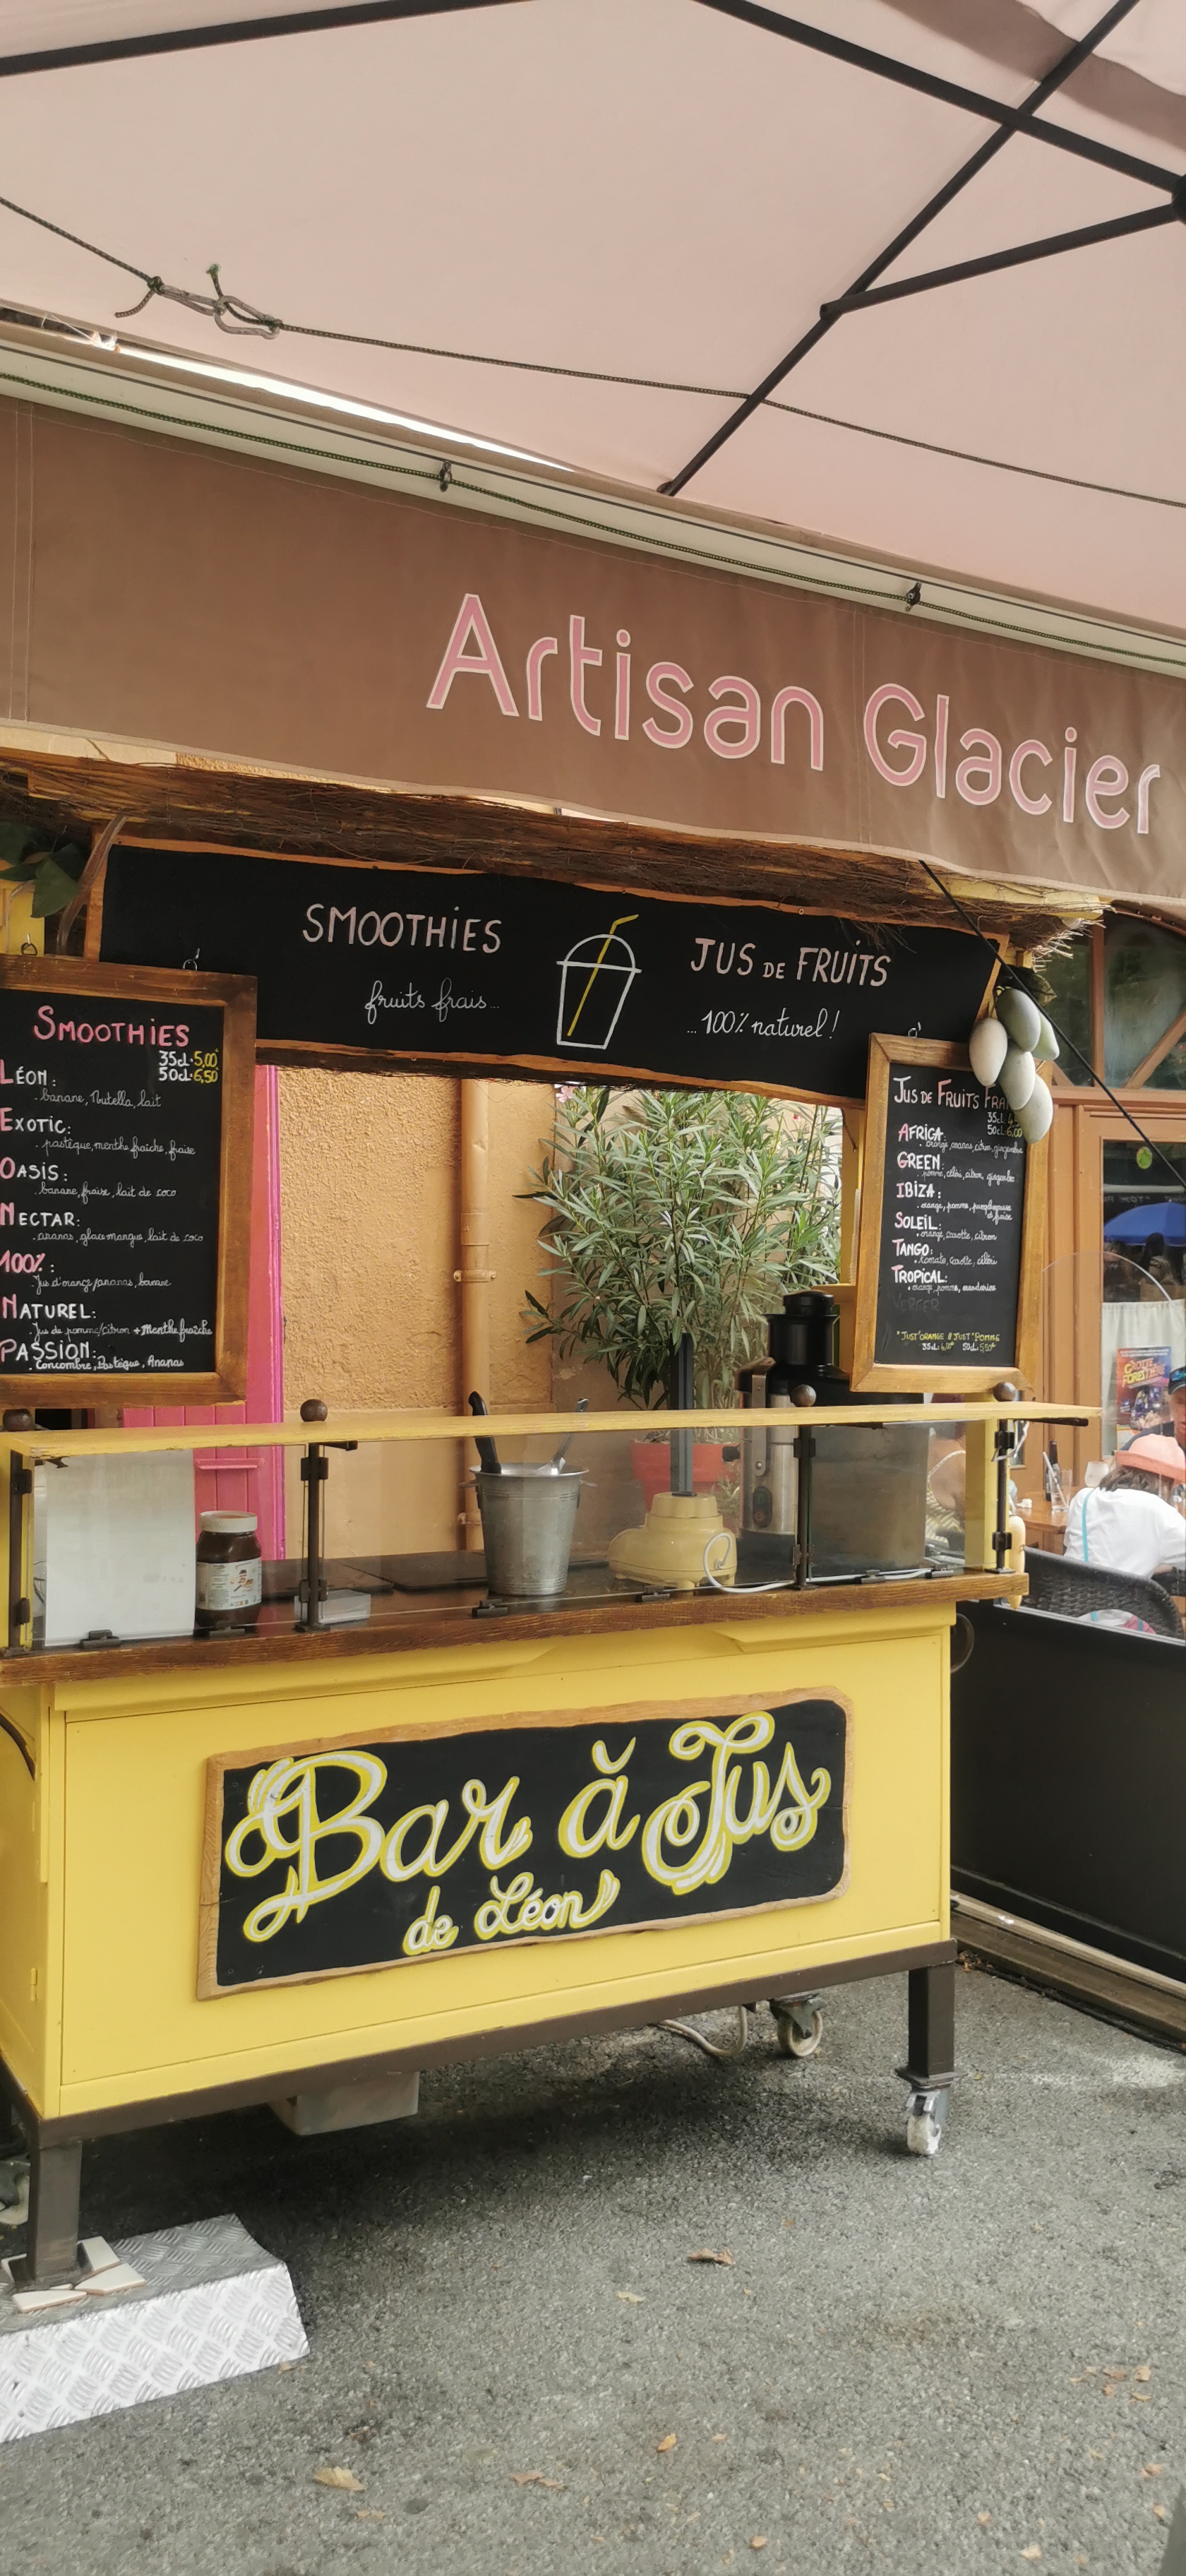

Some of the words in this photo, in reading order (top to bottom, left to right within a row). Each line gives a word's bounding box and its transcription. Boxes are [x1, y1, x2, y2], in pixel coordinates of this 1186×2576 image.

[426, 593, 824, 771] Artisan
[863, 683, 1161, 835] Glacier
[690, 938, 756, 976] JUS
[762, 962, 786, 980] DE
[364, 981, 426, 1025] fruits
[701, 1010, 750, 1035] 100%
[137, 1090, 162, 1107] lait
[893, 1076, 918, 1104] JUS
[921, 1092, 933, 1104] DE
[95, 1136, 130, 1151] menthe
[169, 1140, 196, 1161] fraise
[115, 1182, 137, 1197] lait
[138, 1186, 152, 1197] de
[156, 1188, 177, 1197] coco
[147, 1227, 169, 1241] lait
[169, 1232, 180, 1241] de
[974, 1229, 998, 1241] citron
[32, 1275, 49, 1294] Jus
[138, 1272, 172, 1287] banane
[962, 1281, 997, 1292] mandarine
[32, 1323, 49, 1342] Jus
[51, 1325, 64, 1335] de
[141, 1319, 178, 1337] Menthe
[147, 1355, 185, 1368] Ananas
[225, 1748, 532, 1943] Bar
[641, 1710, 833, 1896] Jus
[402, 1885, 460, 1957] de
[474, 1869, 621, 1941] Léon
